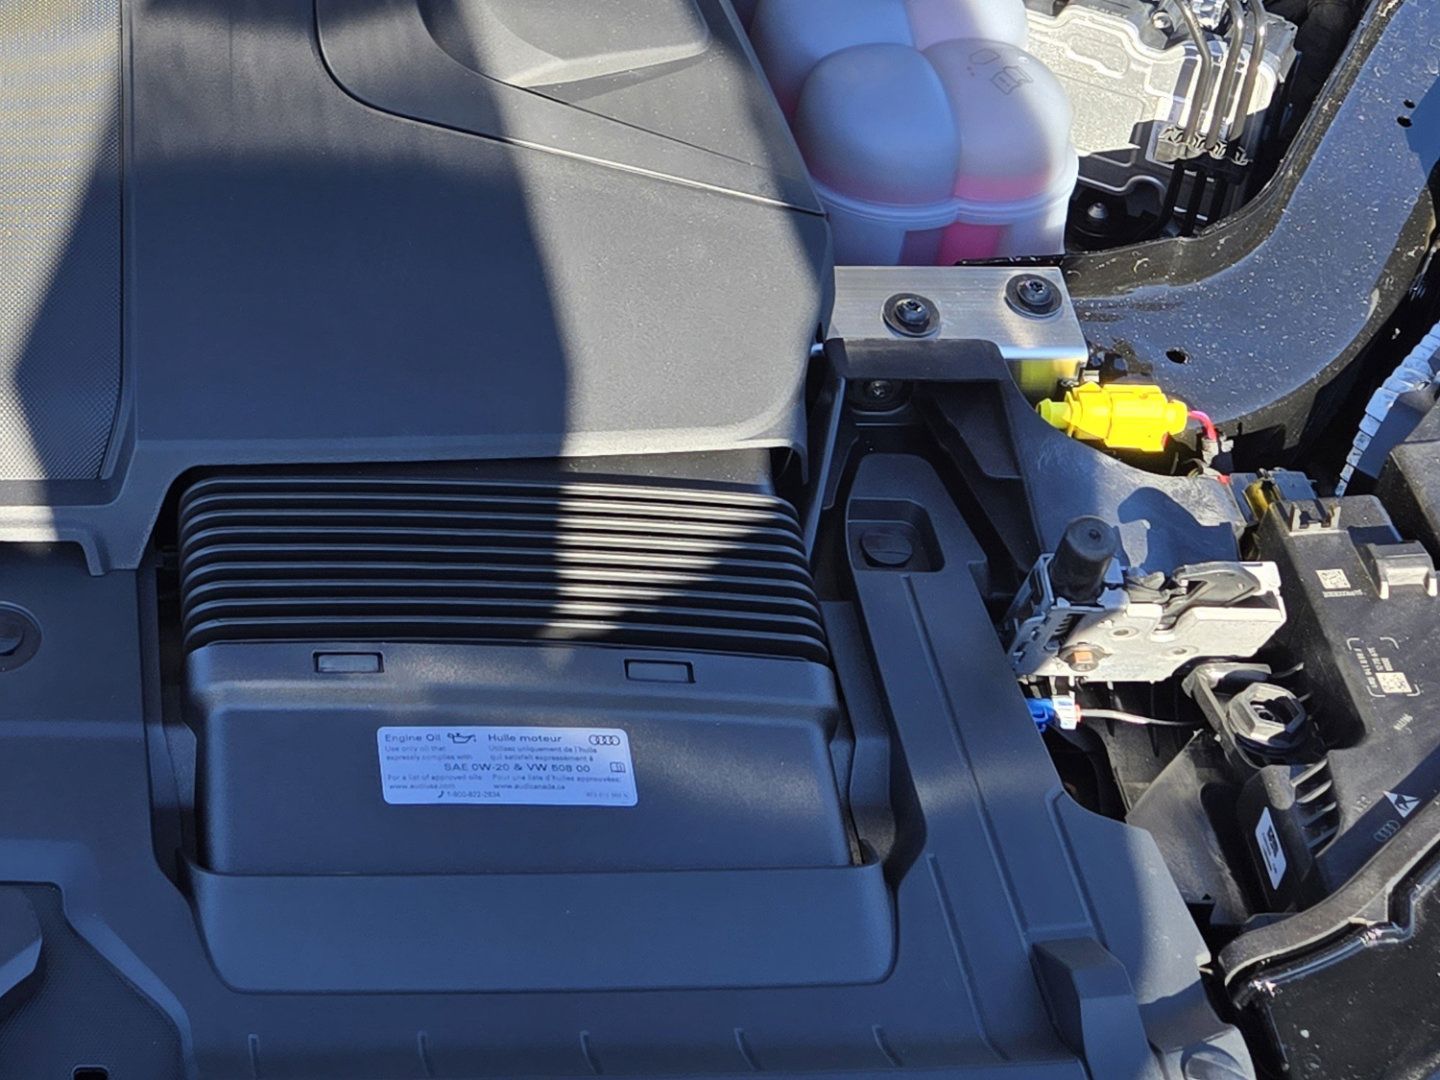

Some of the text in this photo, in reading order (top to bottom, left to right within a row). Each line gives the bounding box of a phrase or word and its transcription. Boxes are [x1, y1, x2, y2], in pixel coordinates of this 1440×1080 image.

[385, 733, 441, 743] Engine Oil
[488, 733, 516, 742] Huile
[444, 763, 591, 773] SAE 0W-20 & VW 508 00
